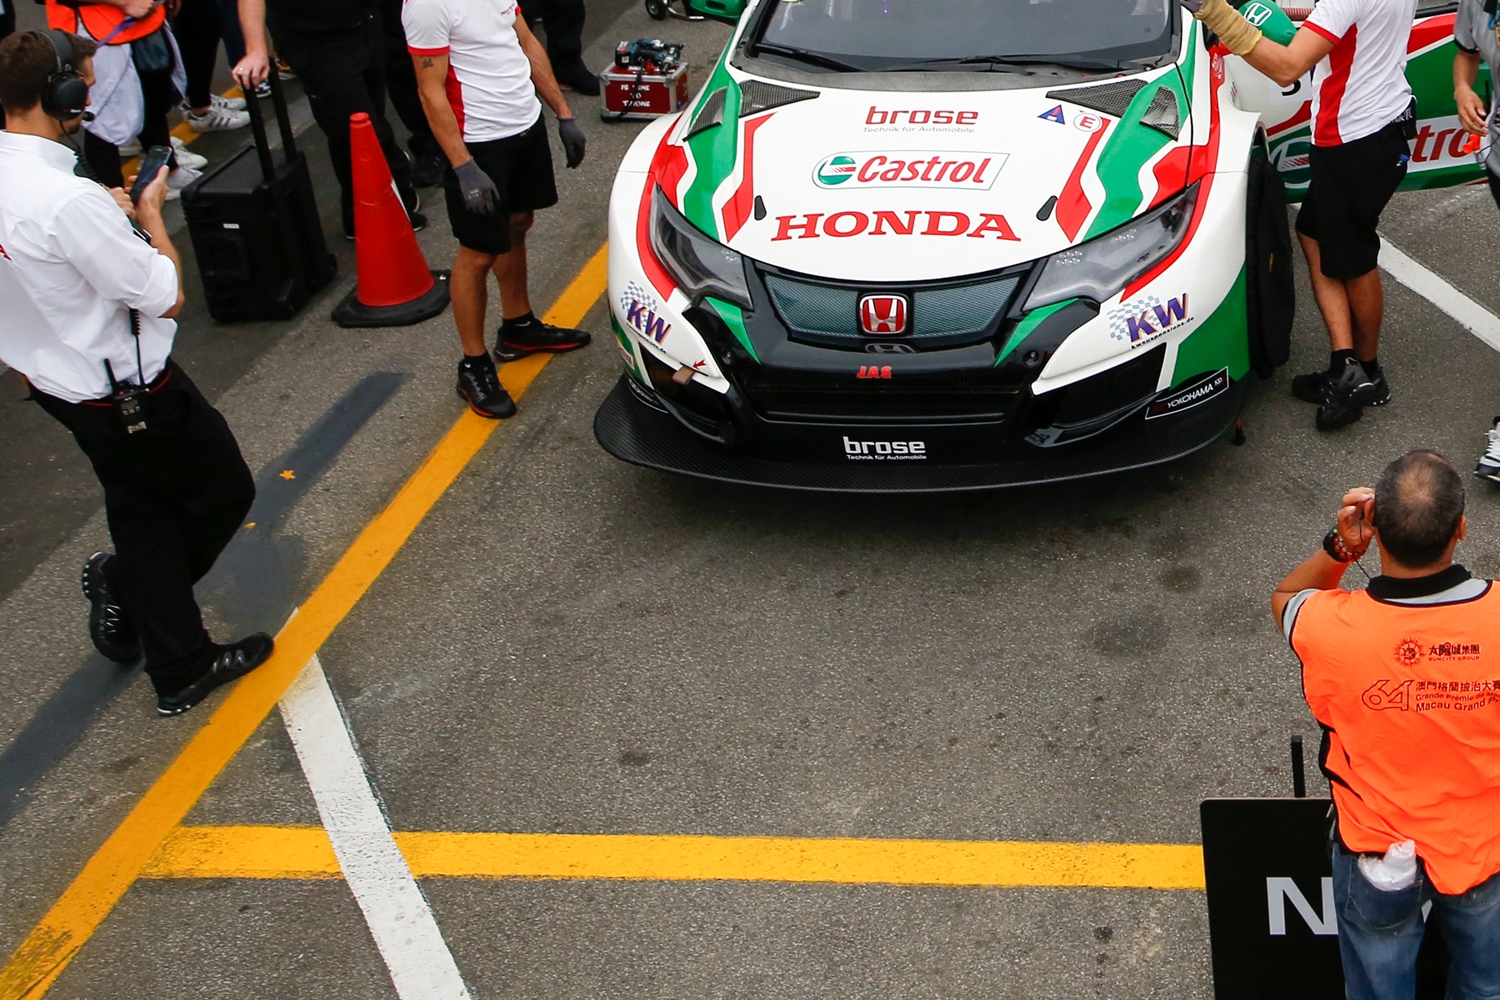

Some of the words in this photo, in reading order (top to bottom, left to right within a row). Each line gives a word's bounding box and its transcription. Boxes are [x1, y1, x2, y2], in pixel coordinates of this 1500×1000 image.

[865, 105, 979, 125] brose
[1079, 116, 1096, 130] E
[863, 126, 900, 134] Technik
[902, 126, 917, 134] für
[918, 126, 976, 134] Automobile
[856, 154, 993, 185] Castrol
[771, 210, 1022, 242] HONDA
[626, 299, 672, 346] KW
[1127, 292, 1190, 343] KW
[856, 365, 892, 379] JAS
[1167, 383, 1213, 408] YOKOHAMA
[843, 435, 926, 456] brose
[886, 454, 927, 462] Automobile
[1362, 679, 1415, 711] 64
[1416, 692, 1444, 702] Grande
[1416, 702, 1450, 713] Macau
[1453, 699, 1486, 712] Grand
